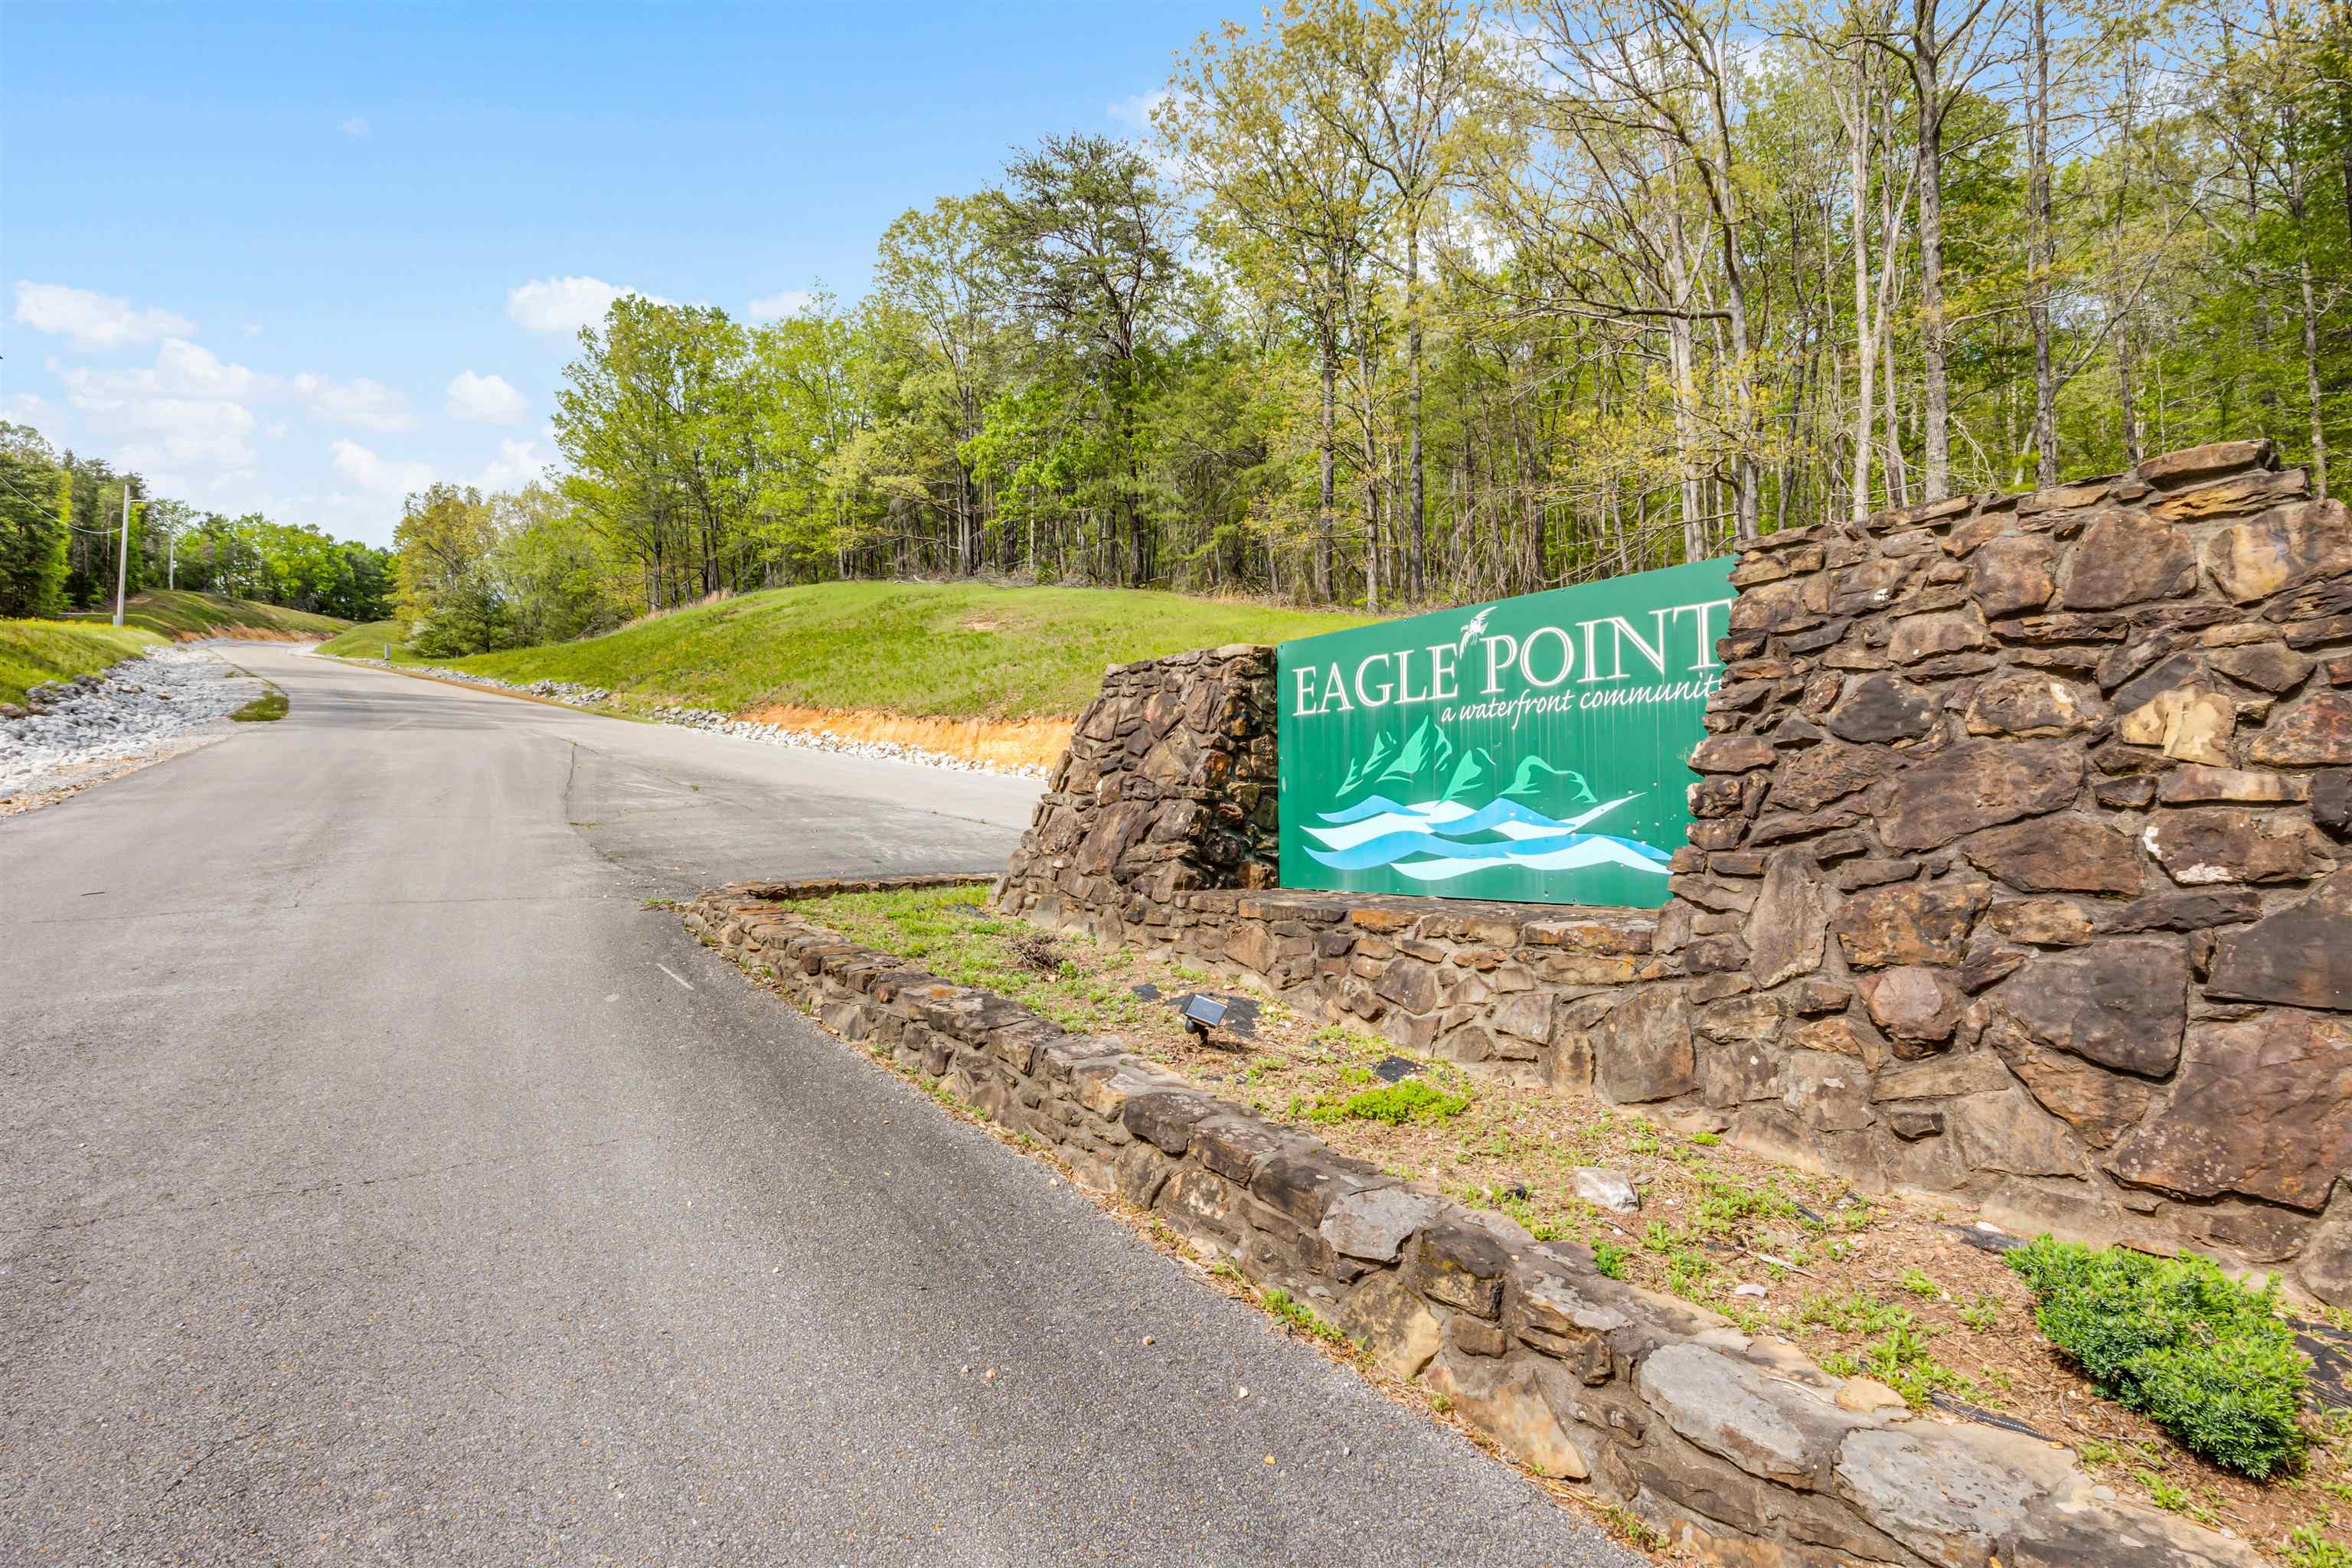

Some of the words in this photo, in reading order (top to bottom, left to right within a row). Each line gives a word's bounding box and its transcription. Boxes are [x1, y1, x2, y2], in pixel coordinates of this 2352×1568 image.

[1292, 642, 1459, 716] EAGLE
[1479, 598, 1732, 694] POINT
[1441, 705, 1456, 724] a
[1459, 688, 1576, 730] waterfront
[1579, 671, 1722, 710] communit
